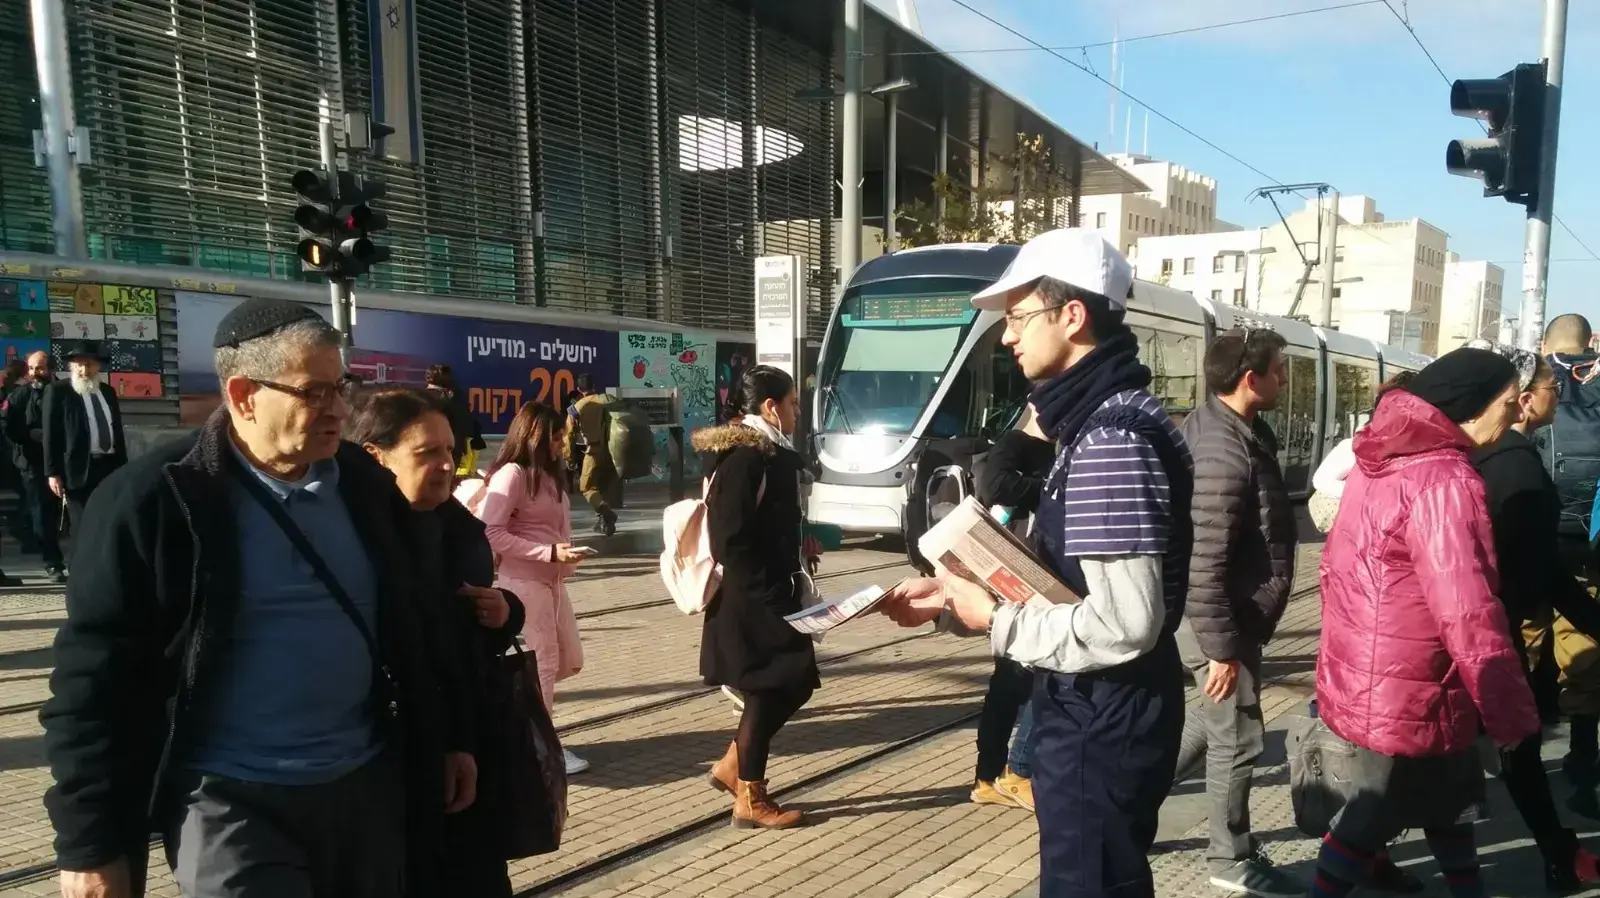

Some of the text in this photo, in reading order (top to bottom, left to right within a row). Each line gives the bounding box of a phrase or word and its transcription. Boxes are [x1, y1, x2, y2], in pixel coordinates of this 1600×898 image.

[467, 335, 526, 362] מודיעין
[541, 338, 598, 364] ירושלים
[469, 387, 524, 423] דקות
[530, 367, 574, 414] 20
